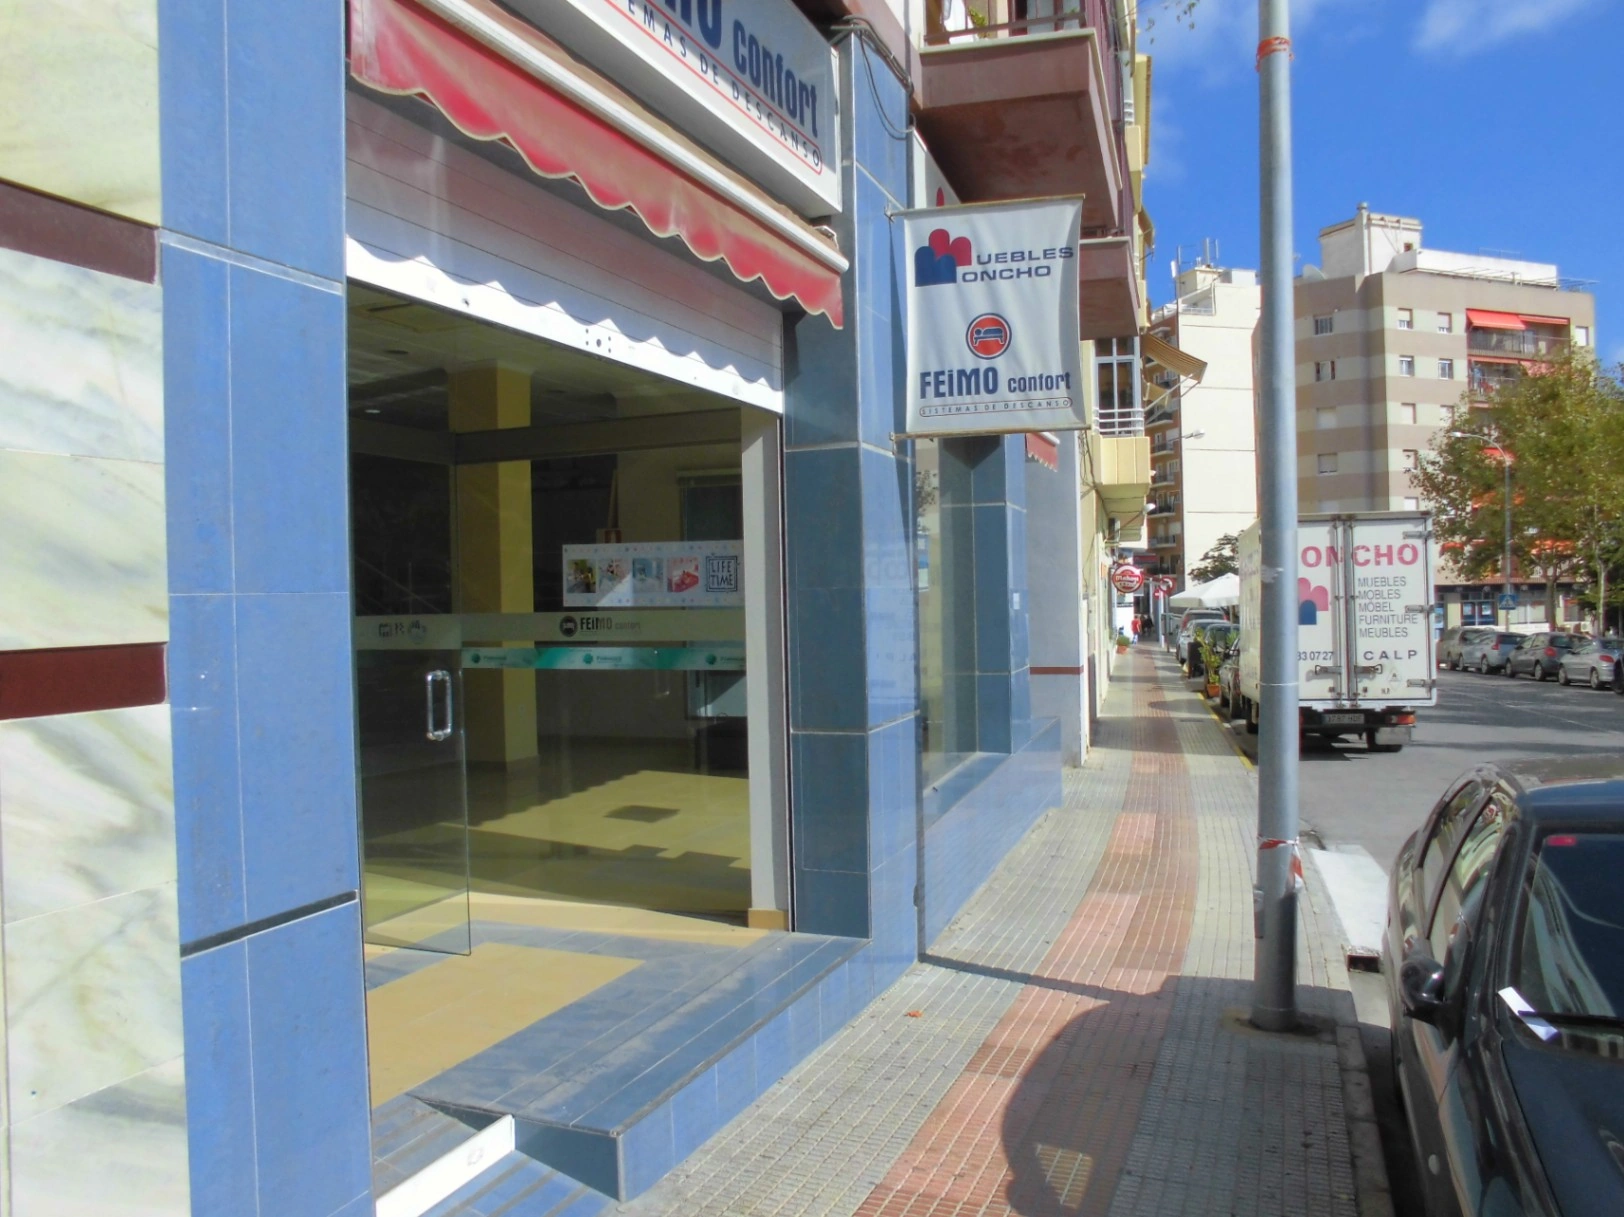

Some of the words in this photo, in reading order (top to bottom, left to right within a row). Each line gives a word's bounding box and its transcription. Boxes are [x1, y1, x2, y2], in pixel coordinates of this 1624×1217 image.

[733, 19, 818, 138] confort
[700, 53, 719, 83] DE
[731, 81, 820, 167] DESCANSO
[962, 265, 1051, 283] ONCHO
[1007, 372, 1071, 393] confort
[921, 404, 978, 415] SISTEMAS
[984, 403, 997, 411] DE
[1003, 399, 1069, 410] DESCANSO
[711, 561, 732, 573] LIFE
[710, 575, 733, 587] TIME
[1358, 576, 1407, 587] MUEBLES
[1359, 614, 1418, 625] FURNITURE
[1359, 627, 1408, 638] MEUBLES
[1363, 650, 1417, 661] CALP
